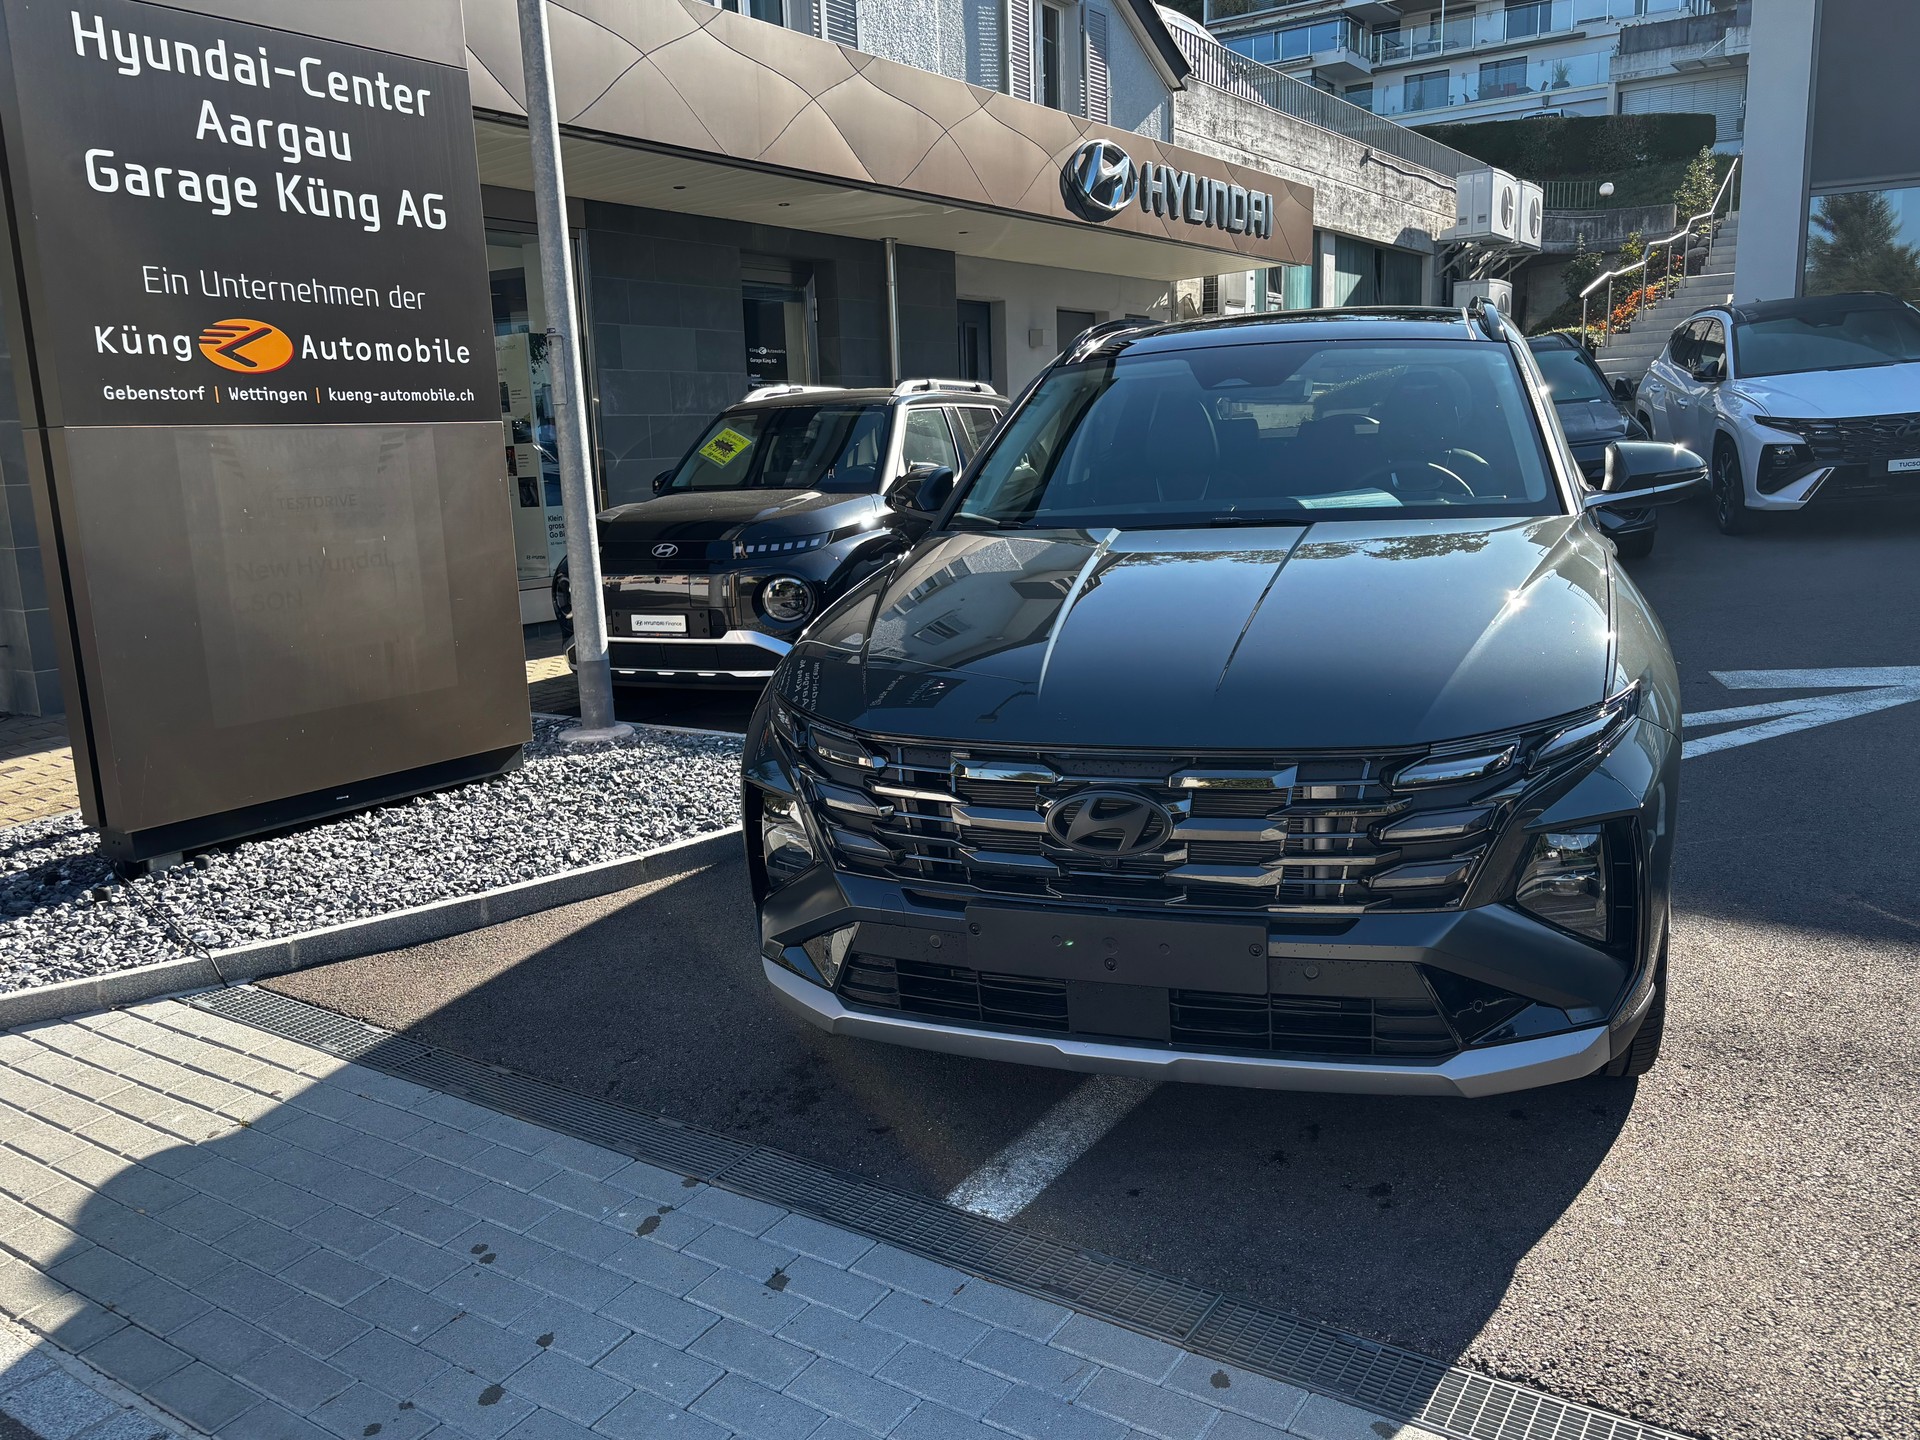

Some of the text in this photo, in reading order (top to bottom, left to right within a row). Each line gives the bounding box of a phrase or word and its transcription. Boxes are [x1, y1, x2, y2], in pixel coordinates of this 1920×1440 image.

[71, 11, 431, 116] Hyundai-Center
[196, 100, 351, 163] Aargau
[85, 148, 447, 232] Garage Küng AG
[1140, 161, 1273, 239] HYUNDAI
[142, 265, 425, 310] Ein Unternehmen der
[94, 326, 471, 364] Küng Automobile
[103, 386, 475, 404] Gebenstorf Wettingen kueng-automobile.ch
